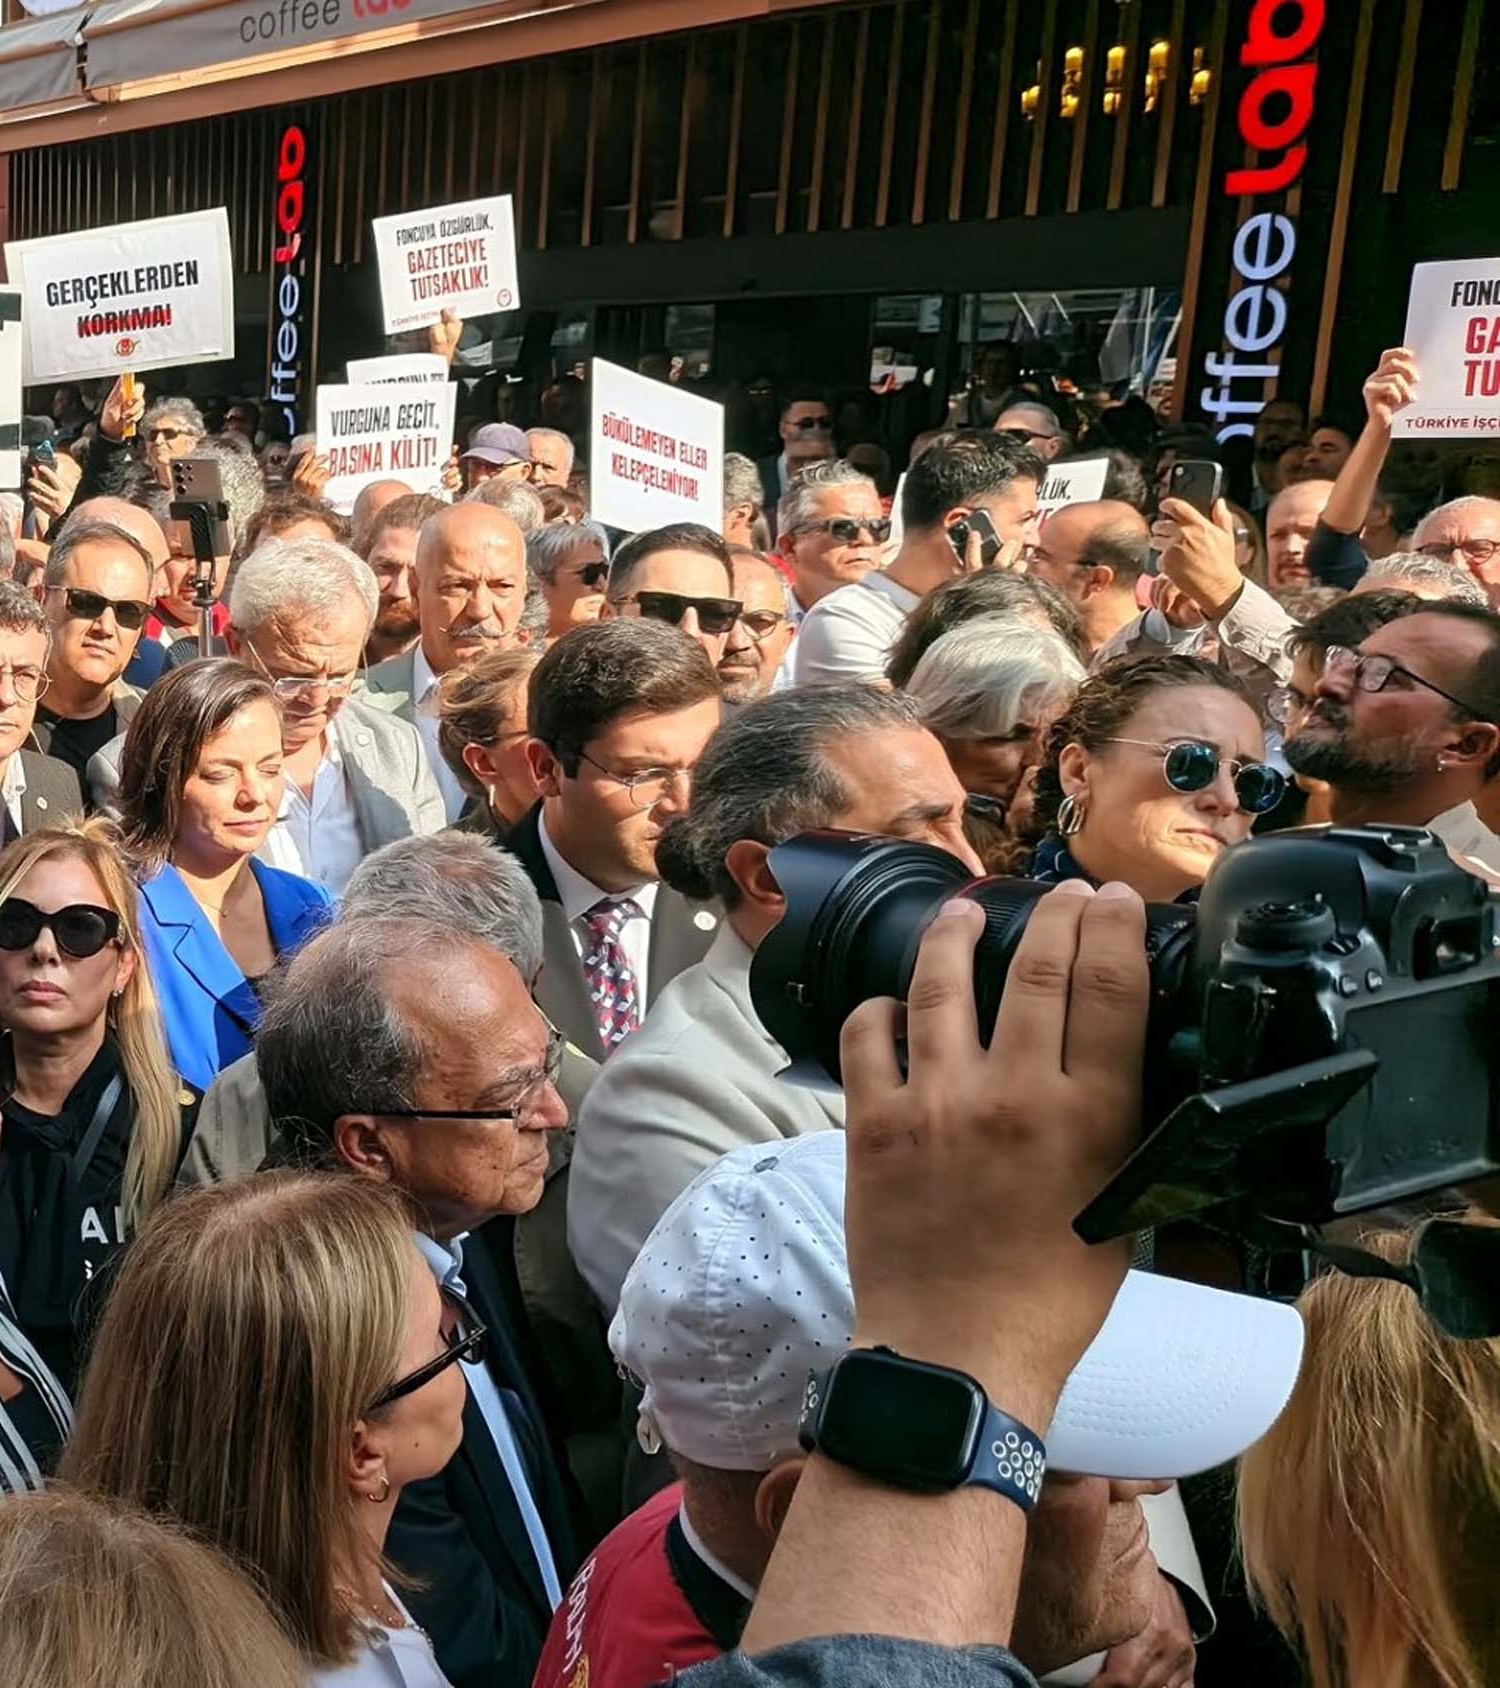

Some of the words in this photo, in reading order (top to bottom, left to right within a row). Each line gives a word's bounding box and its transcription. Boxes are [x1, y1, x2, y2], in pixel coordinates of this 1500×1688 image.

[396, 221, 436, 246] FONCUYA
[46, 259, 199, 309] GERÇEKLERDEN
[409, 265, 490, 302] TUTSAKLIK!
[77, 303, 173, 339] KORKMA!
[1200, 211, 1297, 446] ffee
[270, 273, 300, 436] ffee
[330, 402, 391, 437] VURGUNA
[1406, 415, 1470, 429] TÜRKİYE
[329, 445, 383, 477] BASINA
[390, 434, 438, 470] KİLİT!
[679, 441, 708, 471] ELLER
